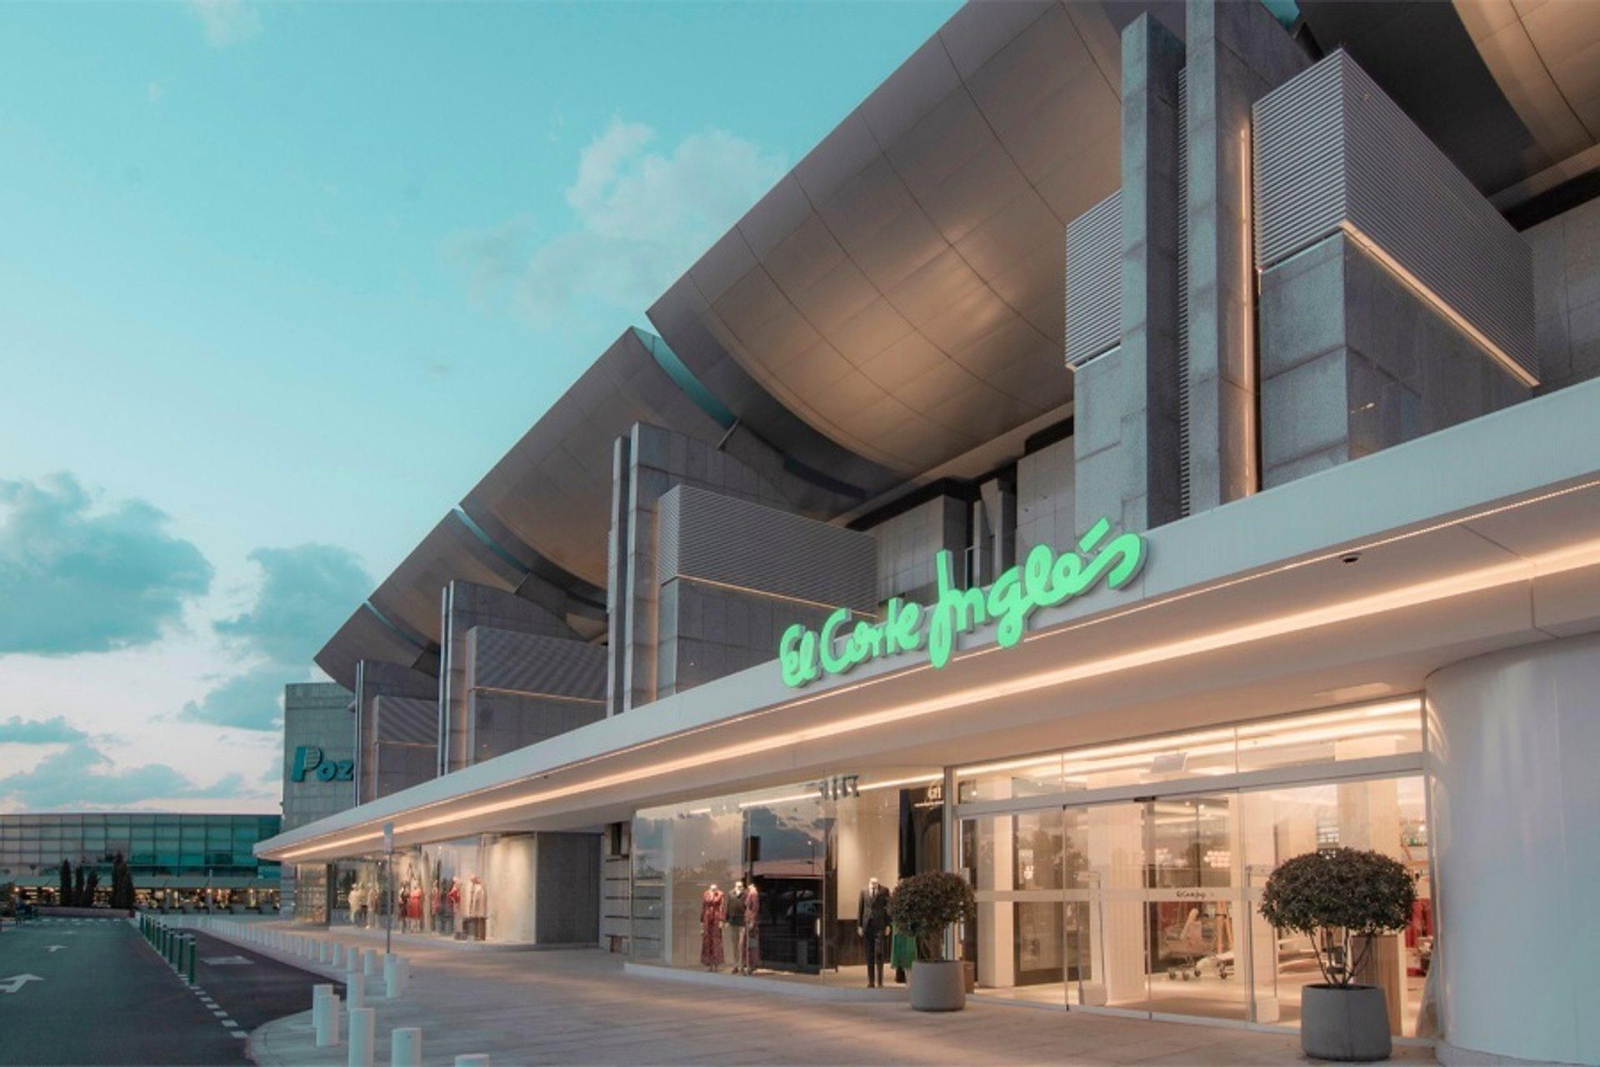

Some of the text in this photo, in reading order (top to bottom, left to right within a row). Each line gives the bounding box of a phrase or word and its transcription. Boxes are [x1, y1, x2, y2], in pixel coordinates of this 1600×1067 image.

[779, 517, 1142, 687] El Corte Inglés
